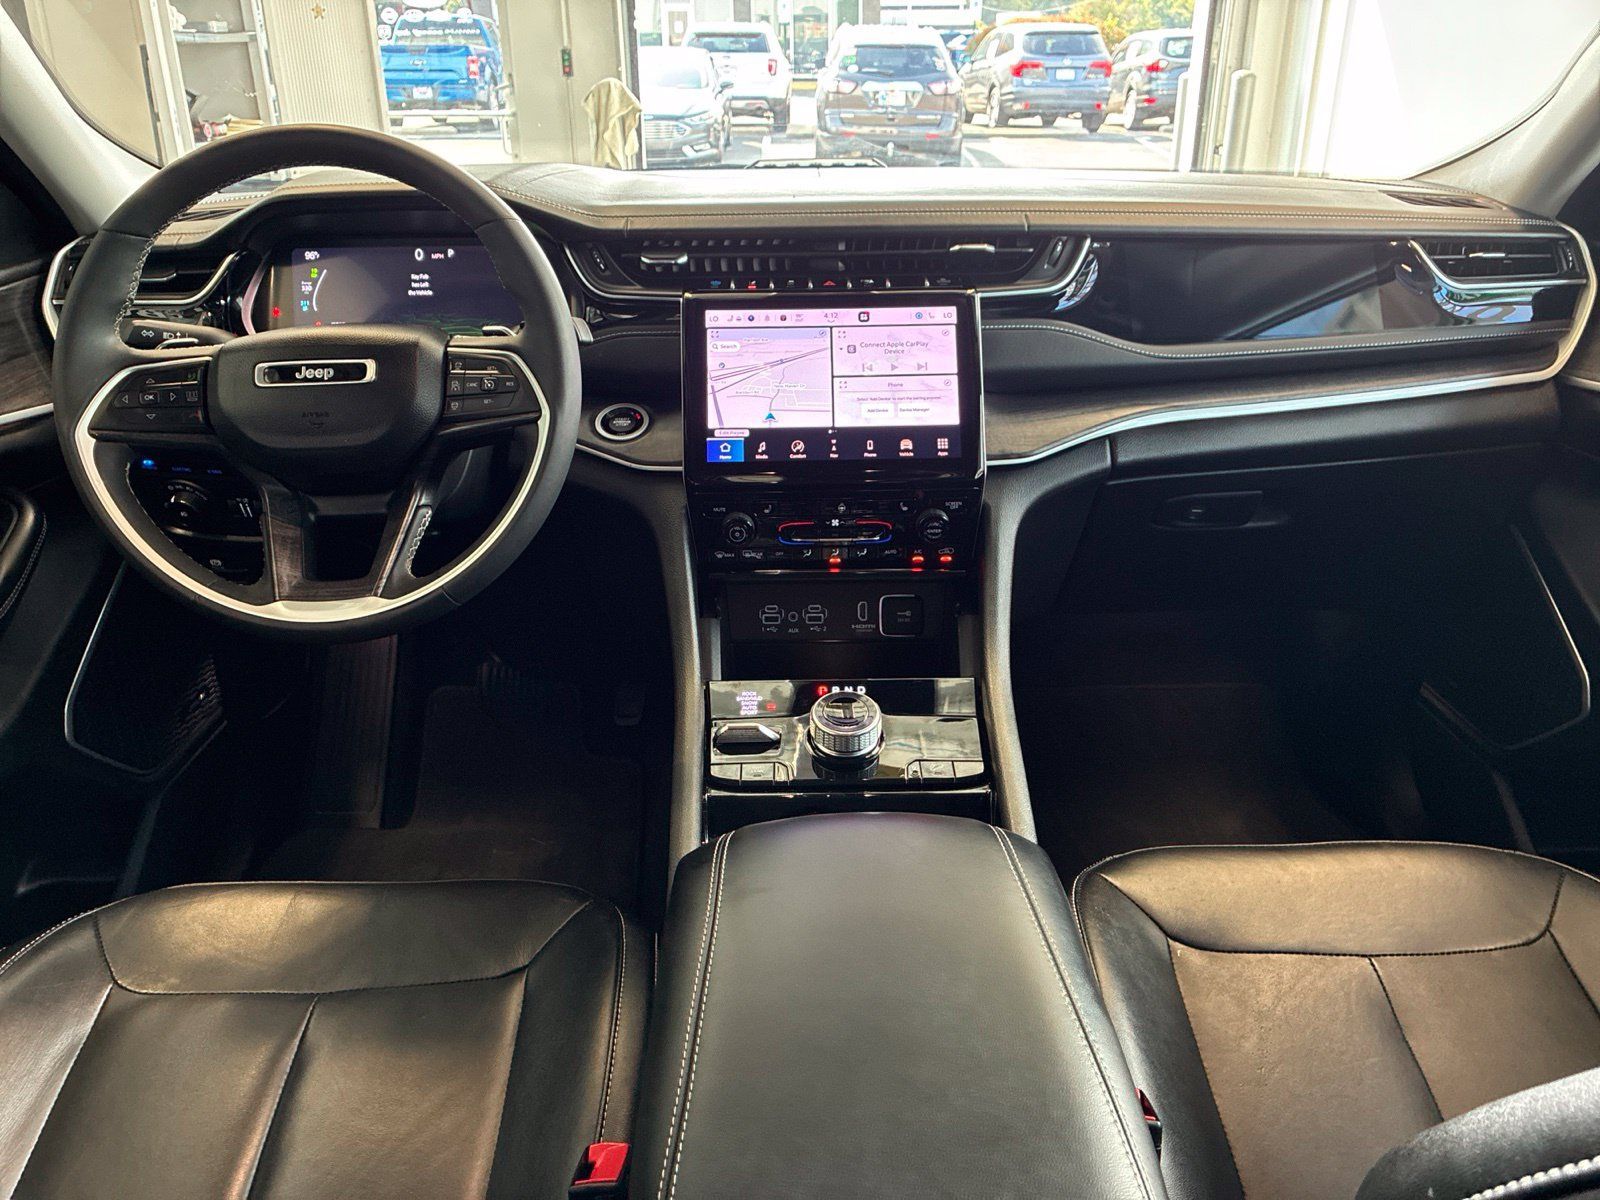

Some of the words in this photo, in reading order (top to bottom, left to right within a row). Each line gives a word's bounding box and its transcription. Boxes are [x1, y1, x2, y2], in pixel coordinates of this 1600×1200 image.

[414, 248, 424, 261] 0
[447, 248, 455, 258] P
[887, 341, 904, 349] Apple
[906, 340, 929, 348] CarPlay
[295, 365, 335, 380] Jeep
[817, 685, 828, 696] P
[856, 685, 866, 695] D
